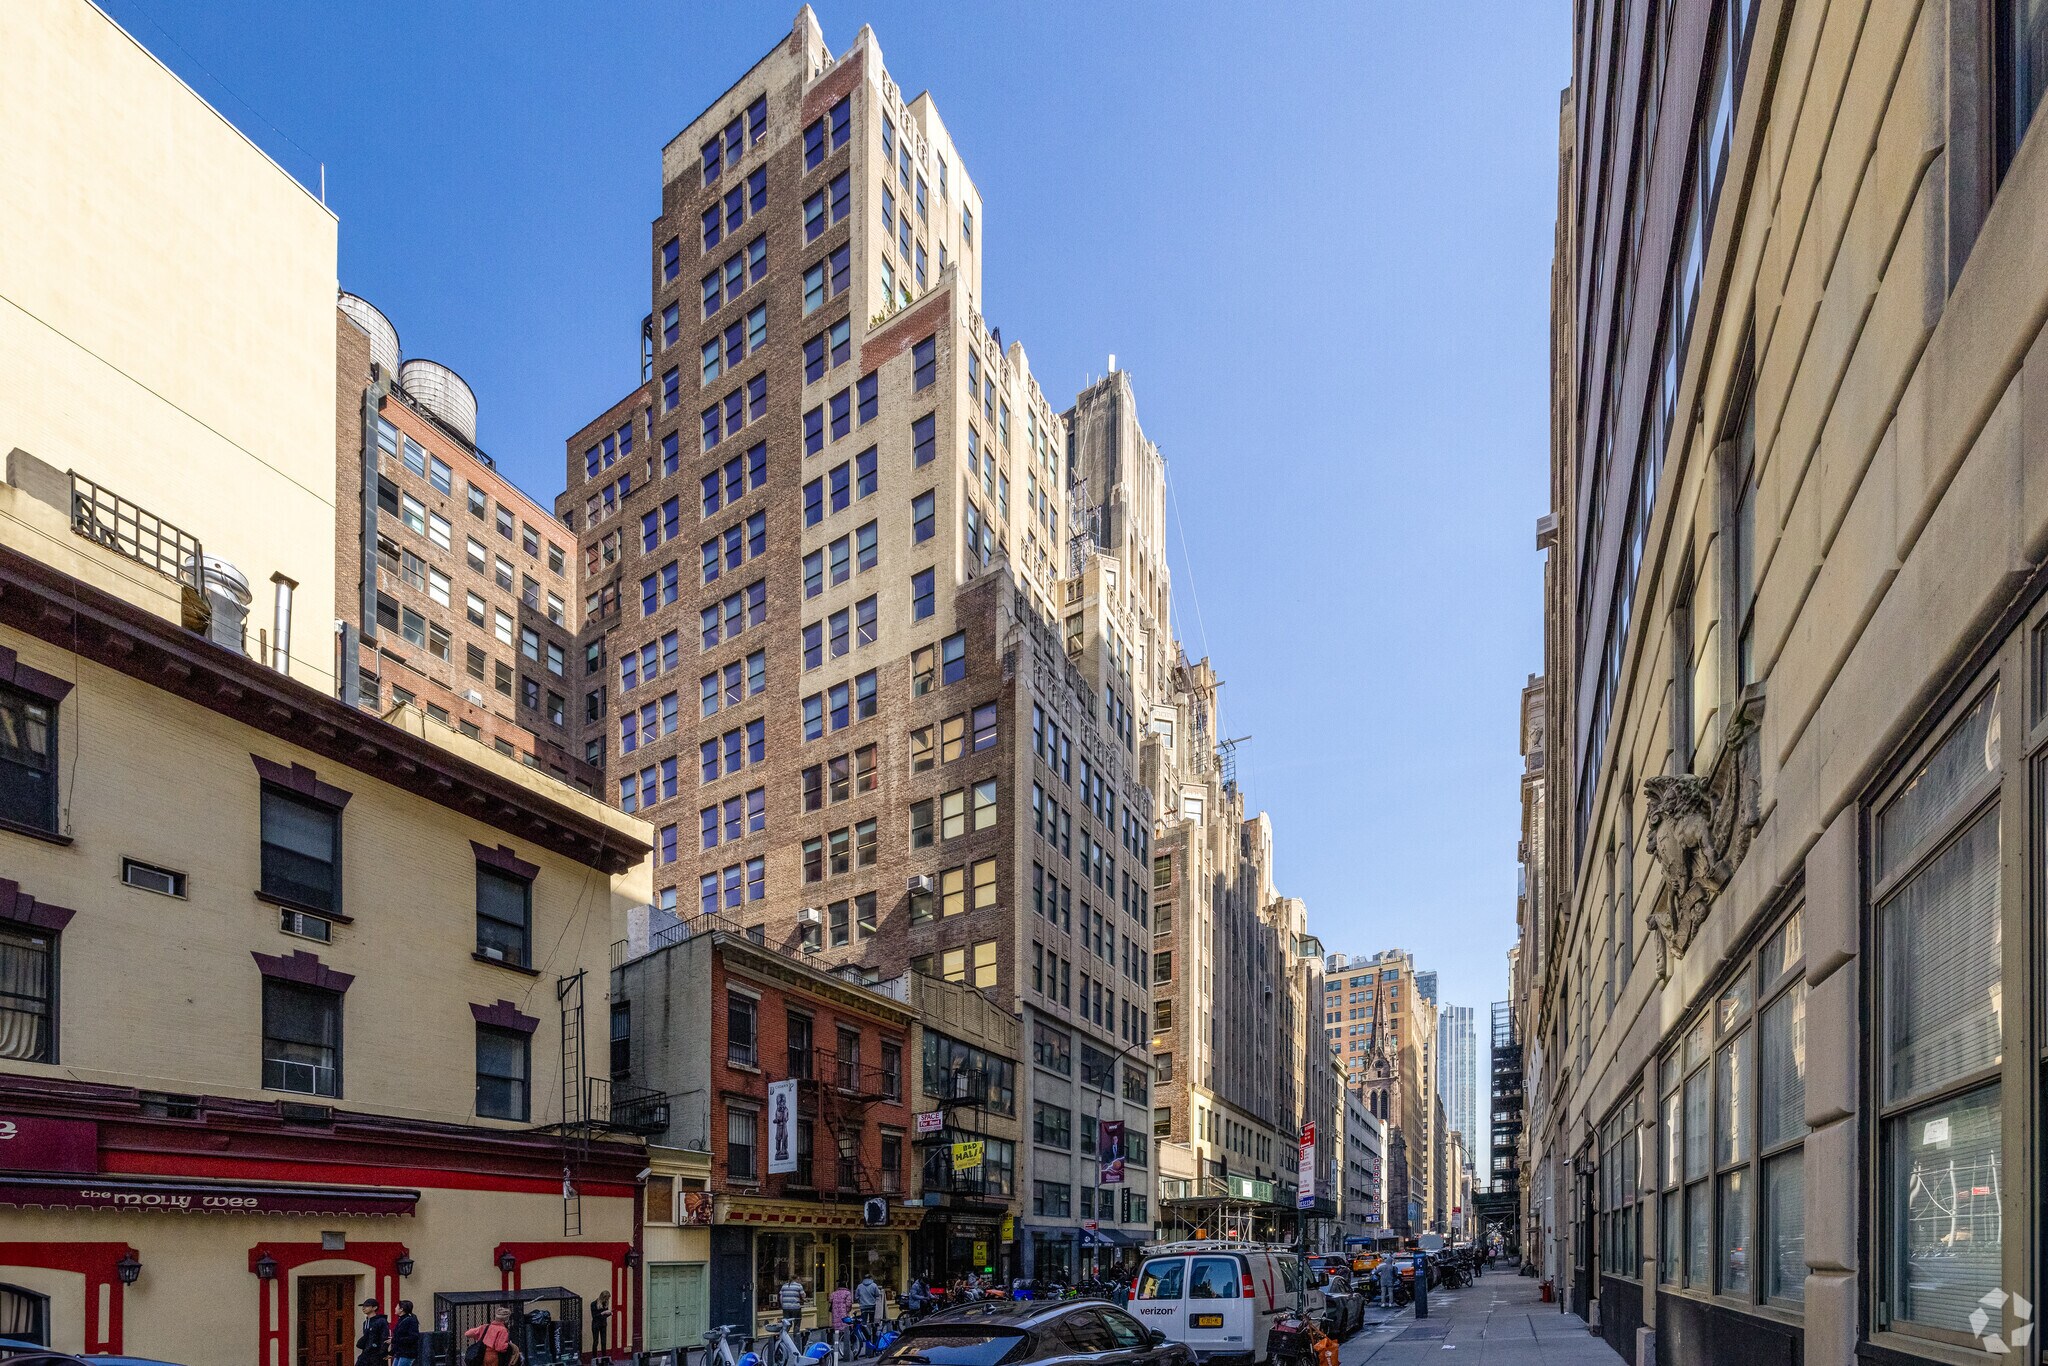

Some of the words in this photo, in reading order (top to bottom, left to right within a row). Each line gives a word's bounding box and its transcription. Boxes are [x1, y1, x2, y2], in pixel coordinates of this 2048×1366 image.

[921, 1112, 939, 1120] SPACE
[81, 1190, 111, 1198] the
[1140, 1306, 1173, 1315] verizon
